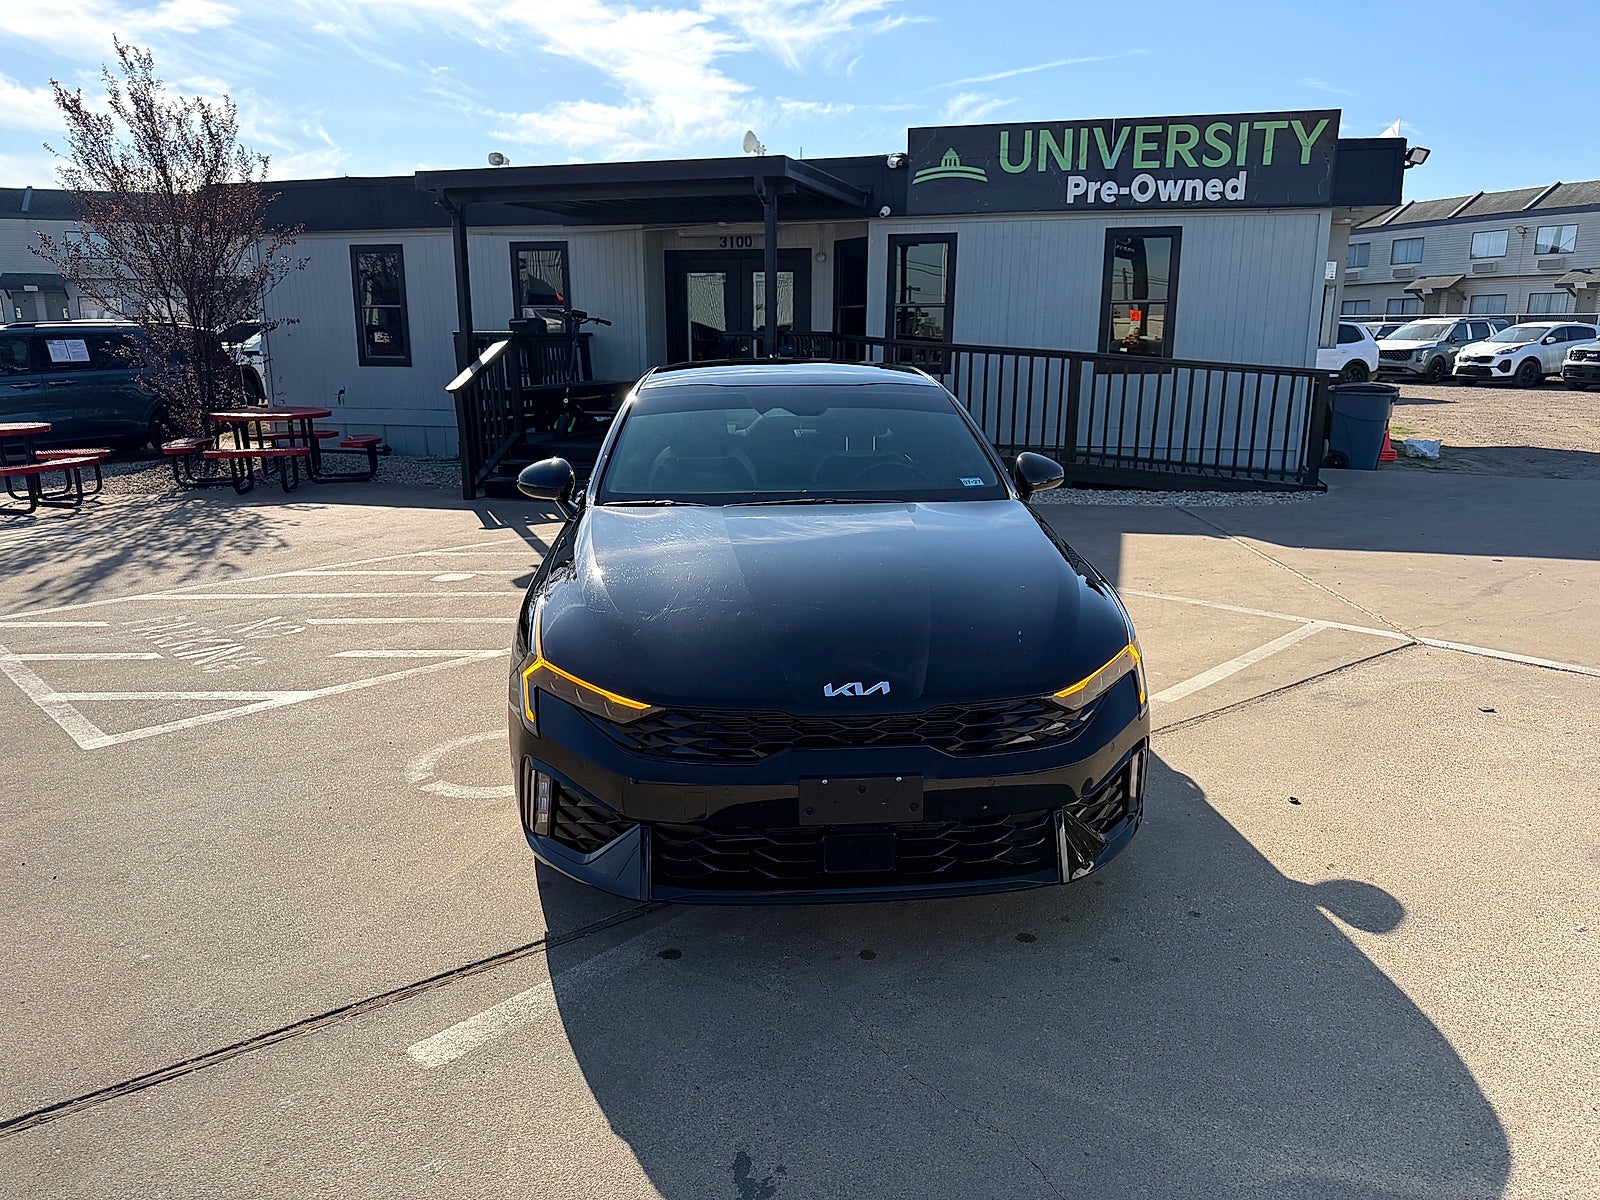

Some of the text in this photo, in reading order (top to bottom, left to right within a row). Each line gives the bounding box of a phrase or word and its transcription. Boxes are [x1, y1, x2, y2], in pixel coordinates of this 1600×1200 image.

[999, 119, 1330, 174] UNIVERSITY
[1066, 171, 1248, 204] Pre-Owned
[719, 235, 753, 249] 3100
[823, 681, 891, 697] KIA
